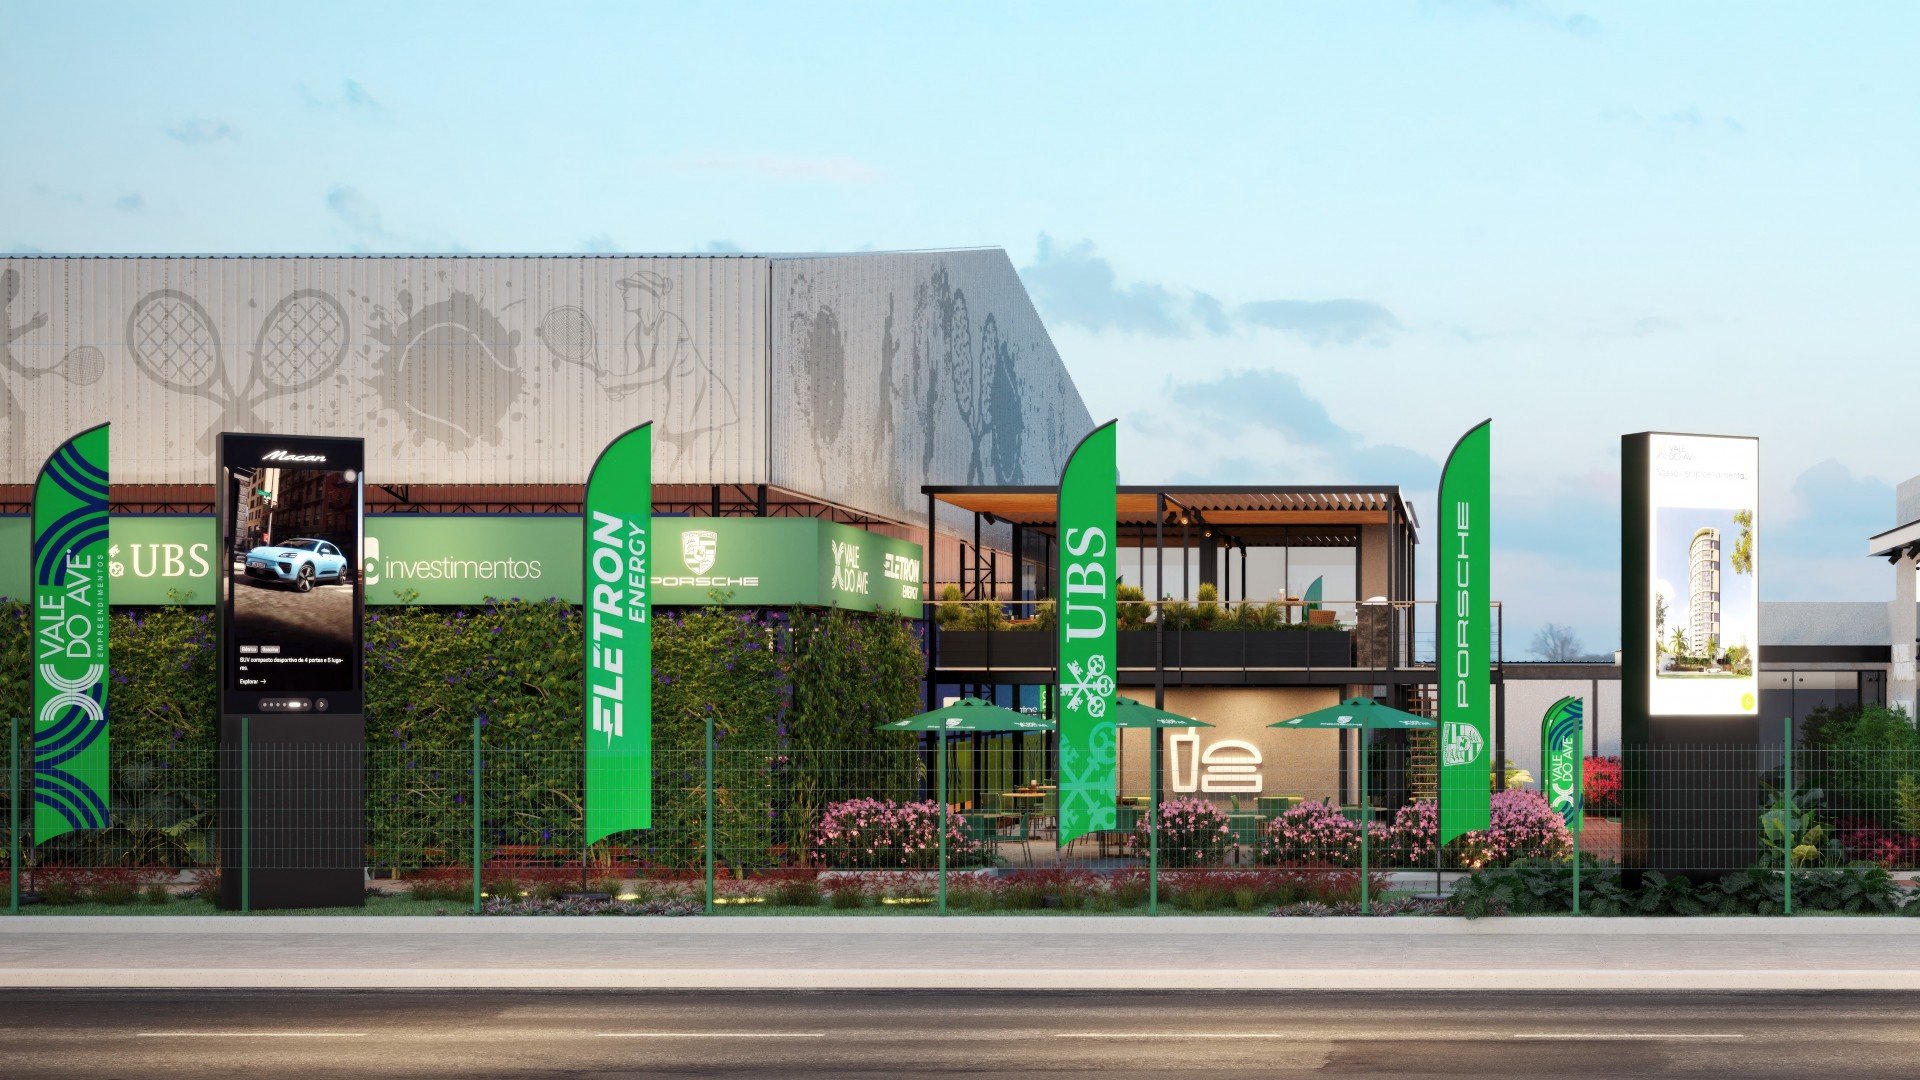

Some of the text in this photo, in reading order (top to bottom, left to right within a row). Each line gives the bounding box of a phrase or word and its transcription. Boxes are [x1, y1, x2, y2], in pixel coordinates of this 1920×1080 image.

[262, 449, 327, 462] Macan
[130, 543, 210, 578] UBS
[385, 555, 541, 579] investimentos
[628, 520, 645, 624] ENERGY
[844, 543, 860, 569] VALE
[883, 552, 920, 584] ELETRON
[651, 576, 759, 587] PORSCHE
[844, 568, 869, 595] DO AVE
[1065, 526, 1107, 643] UBS
[66, 554, 92, 658] DO AVE
[1457, 502, 1469, 708] PORSCHE
[40, 595, 65, 659] VALE
[592, 510, 623, 742] ELETRON
[1551, 754, 1563, 781] VALE
[1562, 736, 1573, 781] DO AVE
